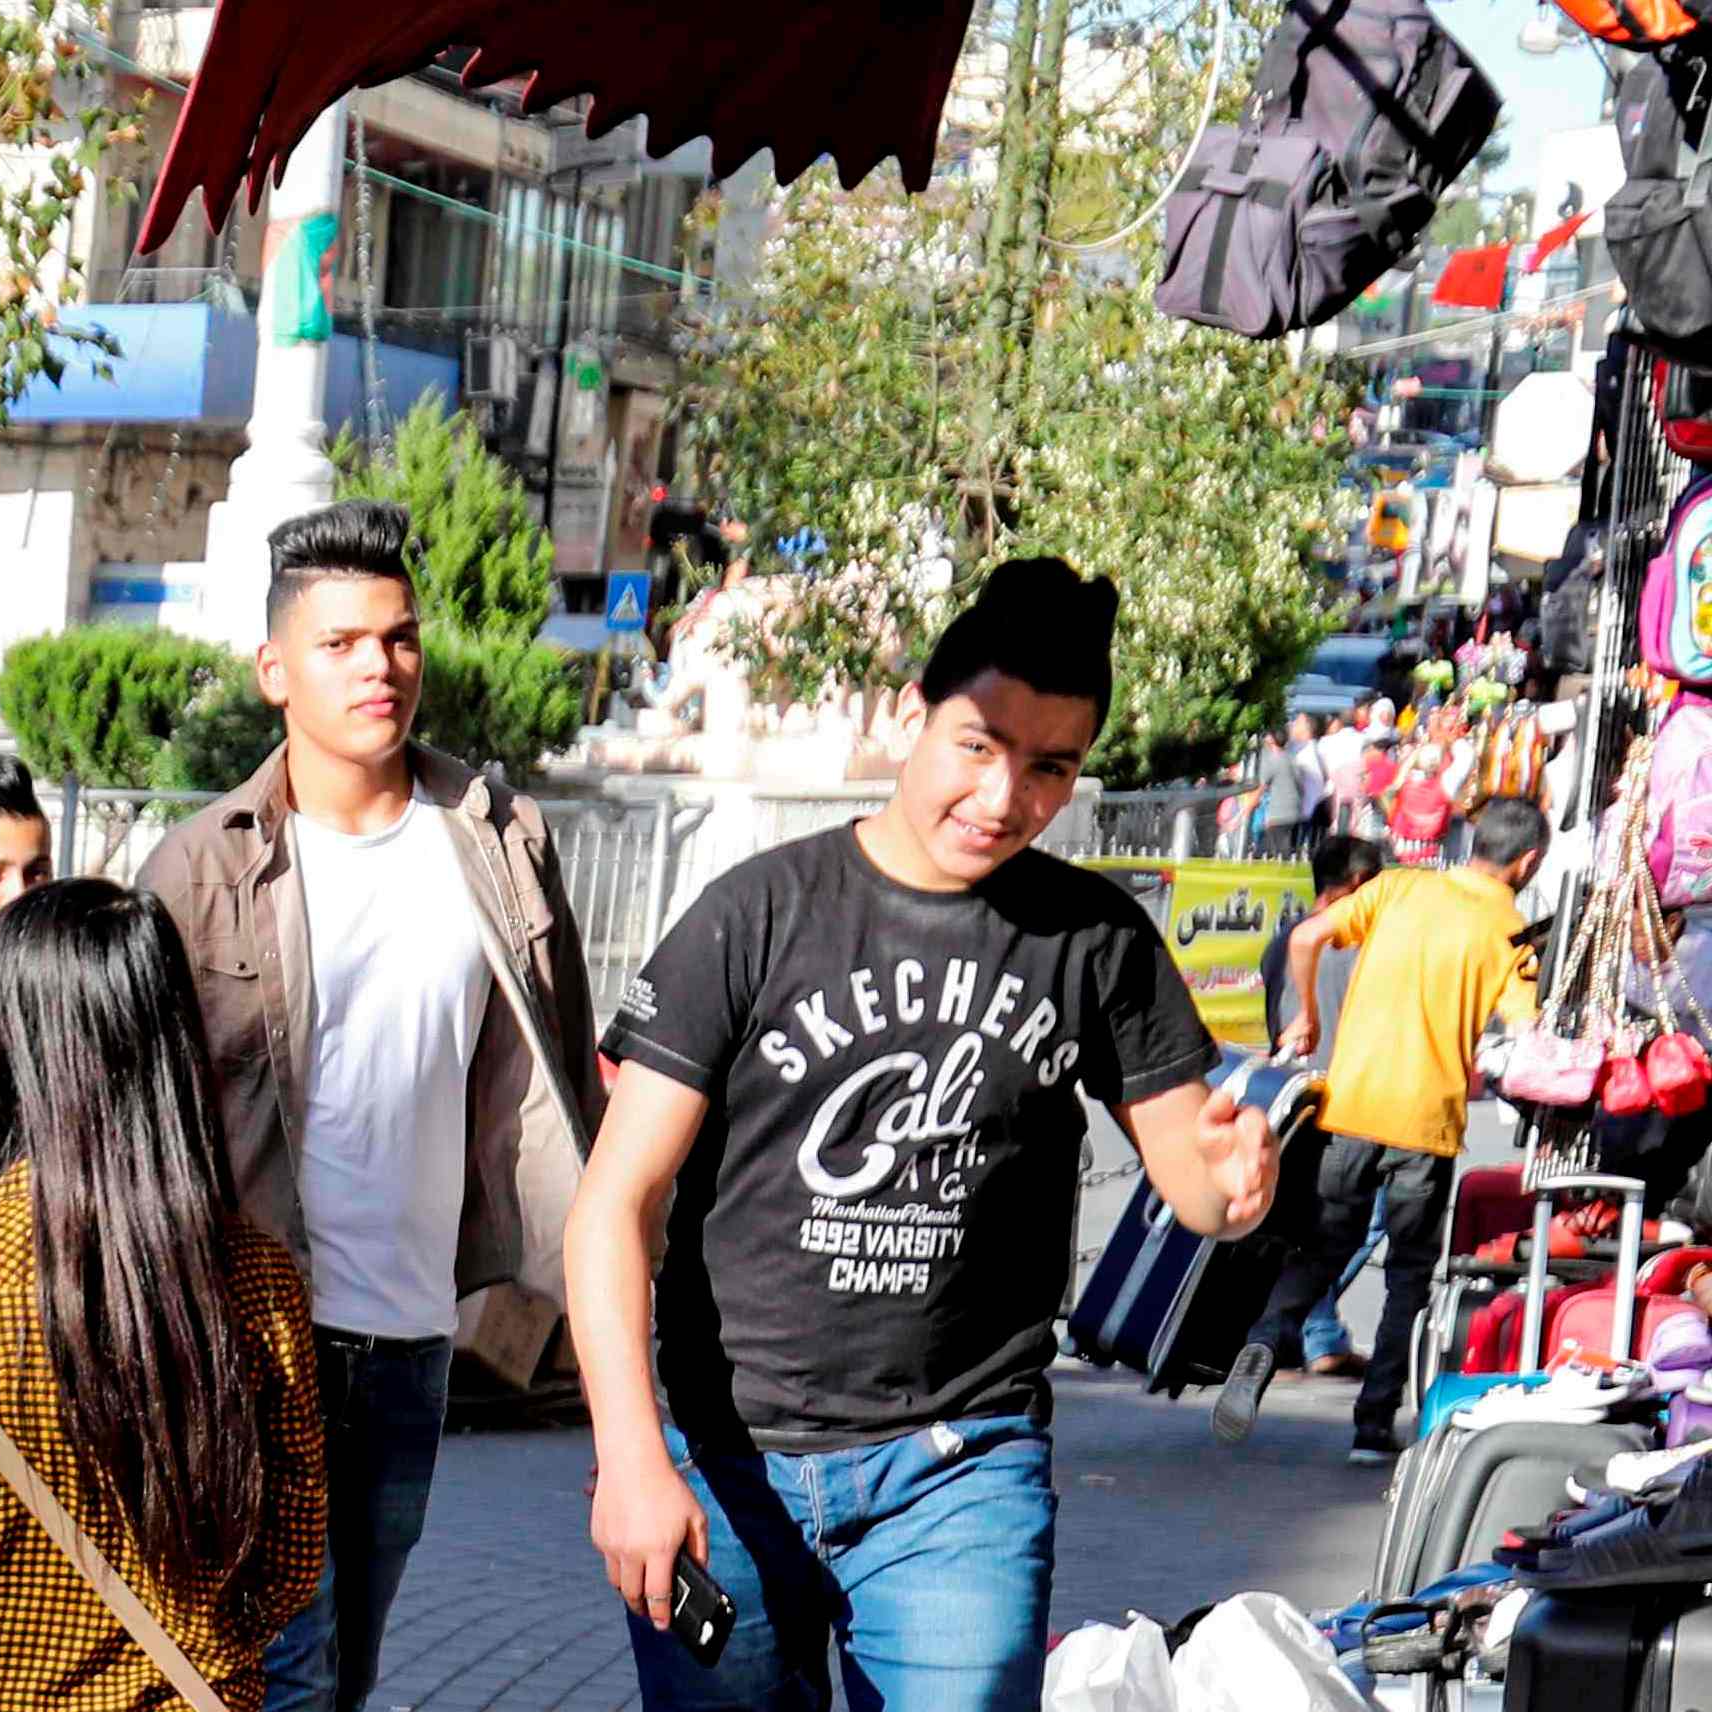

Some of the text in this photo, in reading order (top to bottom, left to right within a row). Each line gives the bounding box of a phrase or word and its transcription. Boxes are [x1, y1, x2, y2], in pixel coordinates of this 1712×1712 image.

[759, 957, 1080, 1085] SKECHERS
[797, 1031, 985, 1197] Cali
[903, 1203, 963, 1226] Beach
[800, 1218, 966, 1259] 1992 VARSITY
[828, 1257, 931, 1295] CHAMPS
